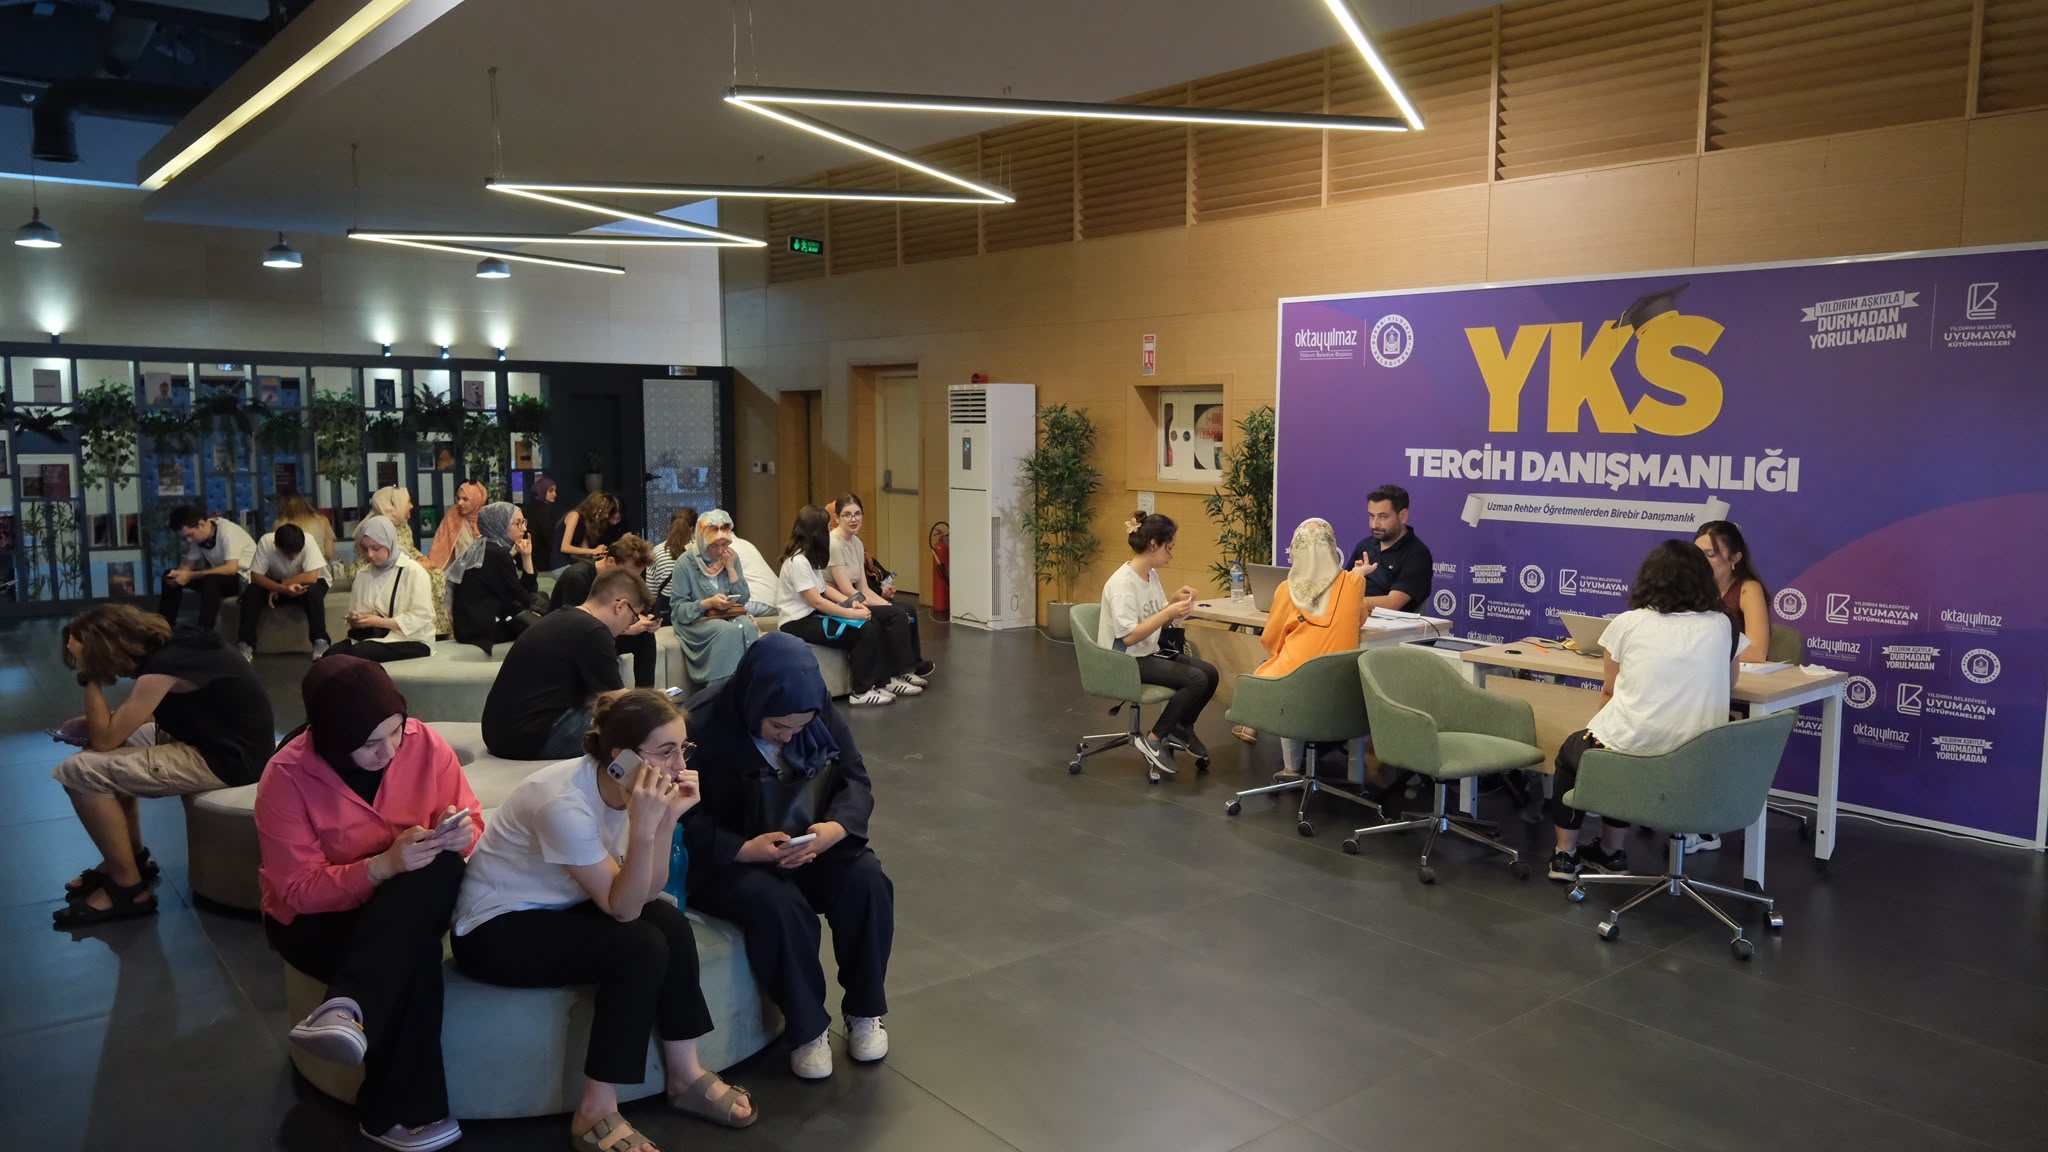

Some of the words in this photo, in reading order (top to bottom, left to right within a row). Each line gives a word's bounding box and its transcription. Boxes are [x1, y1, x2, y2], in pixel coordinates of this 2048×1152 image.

[1819, 298, 1859, 313] YILDIRIM
[1860, 293, 1901, 308] AŞKIYLA
[1817, 307, 1900, 332] DURMADAN
[1809, 323, 1908, 349] YORULMADAN
[1944, 330, 2017, 341] UYUMAYAN
[1947, 340, 2011, 348] KÜTÜPHANELERİ
[1464, 314, 1725, 436] YKS
[1405, 443, 1516, 481] TERCİH
[1521, 448, 1800, 492] DANIŞMANLIĞI
[1487, 502, 1513, 512] Uzman
[1513, 503, 1541, 513] Rehber
[1542, 503, 1610, 518] Öğretmenlerden
[1610, 508, 1640, 520] Birebir
[1640, 510, 1696, 523] Danışmanlık
[1580, 580, 1629, 592] UYUMAYAN
[1487, 605, 1531, 616] UYUMAYAN
[1853, 607, 1919, 620] UYUMAYAN
[1853, 615, 1909, 626] KÜTÜPHANELERİ
[1889, 653, 1931, 662] DURMADAN
[1886, 661, 1935, 670] YORULMADAN
[1927, 692, 1953, 700] YILDIRIM
[1953, 695, 1987, 704] BELEDİYESİ
[1926, 698, 1996, 715] UYUMAYAN
[1926, 707, 1986, 720] KÜTÜPHANELERİ
[1940, 743, 1983, 754] DURMADAN
[1936, 751, 1987, 763] YORULMADAN
